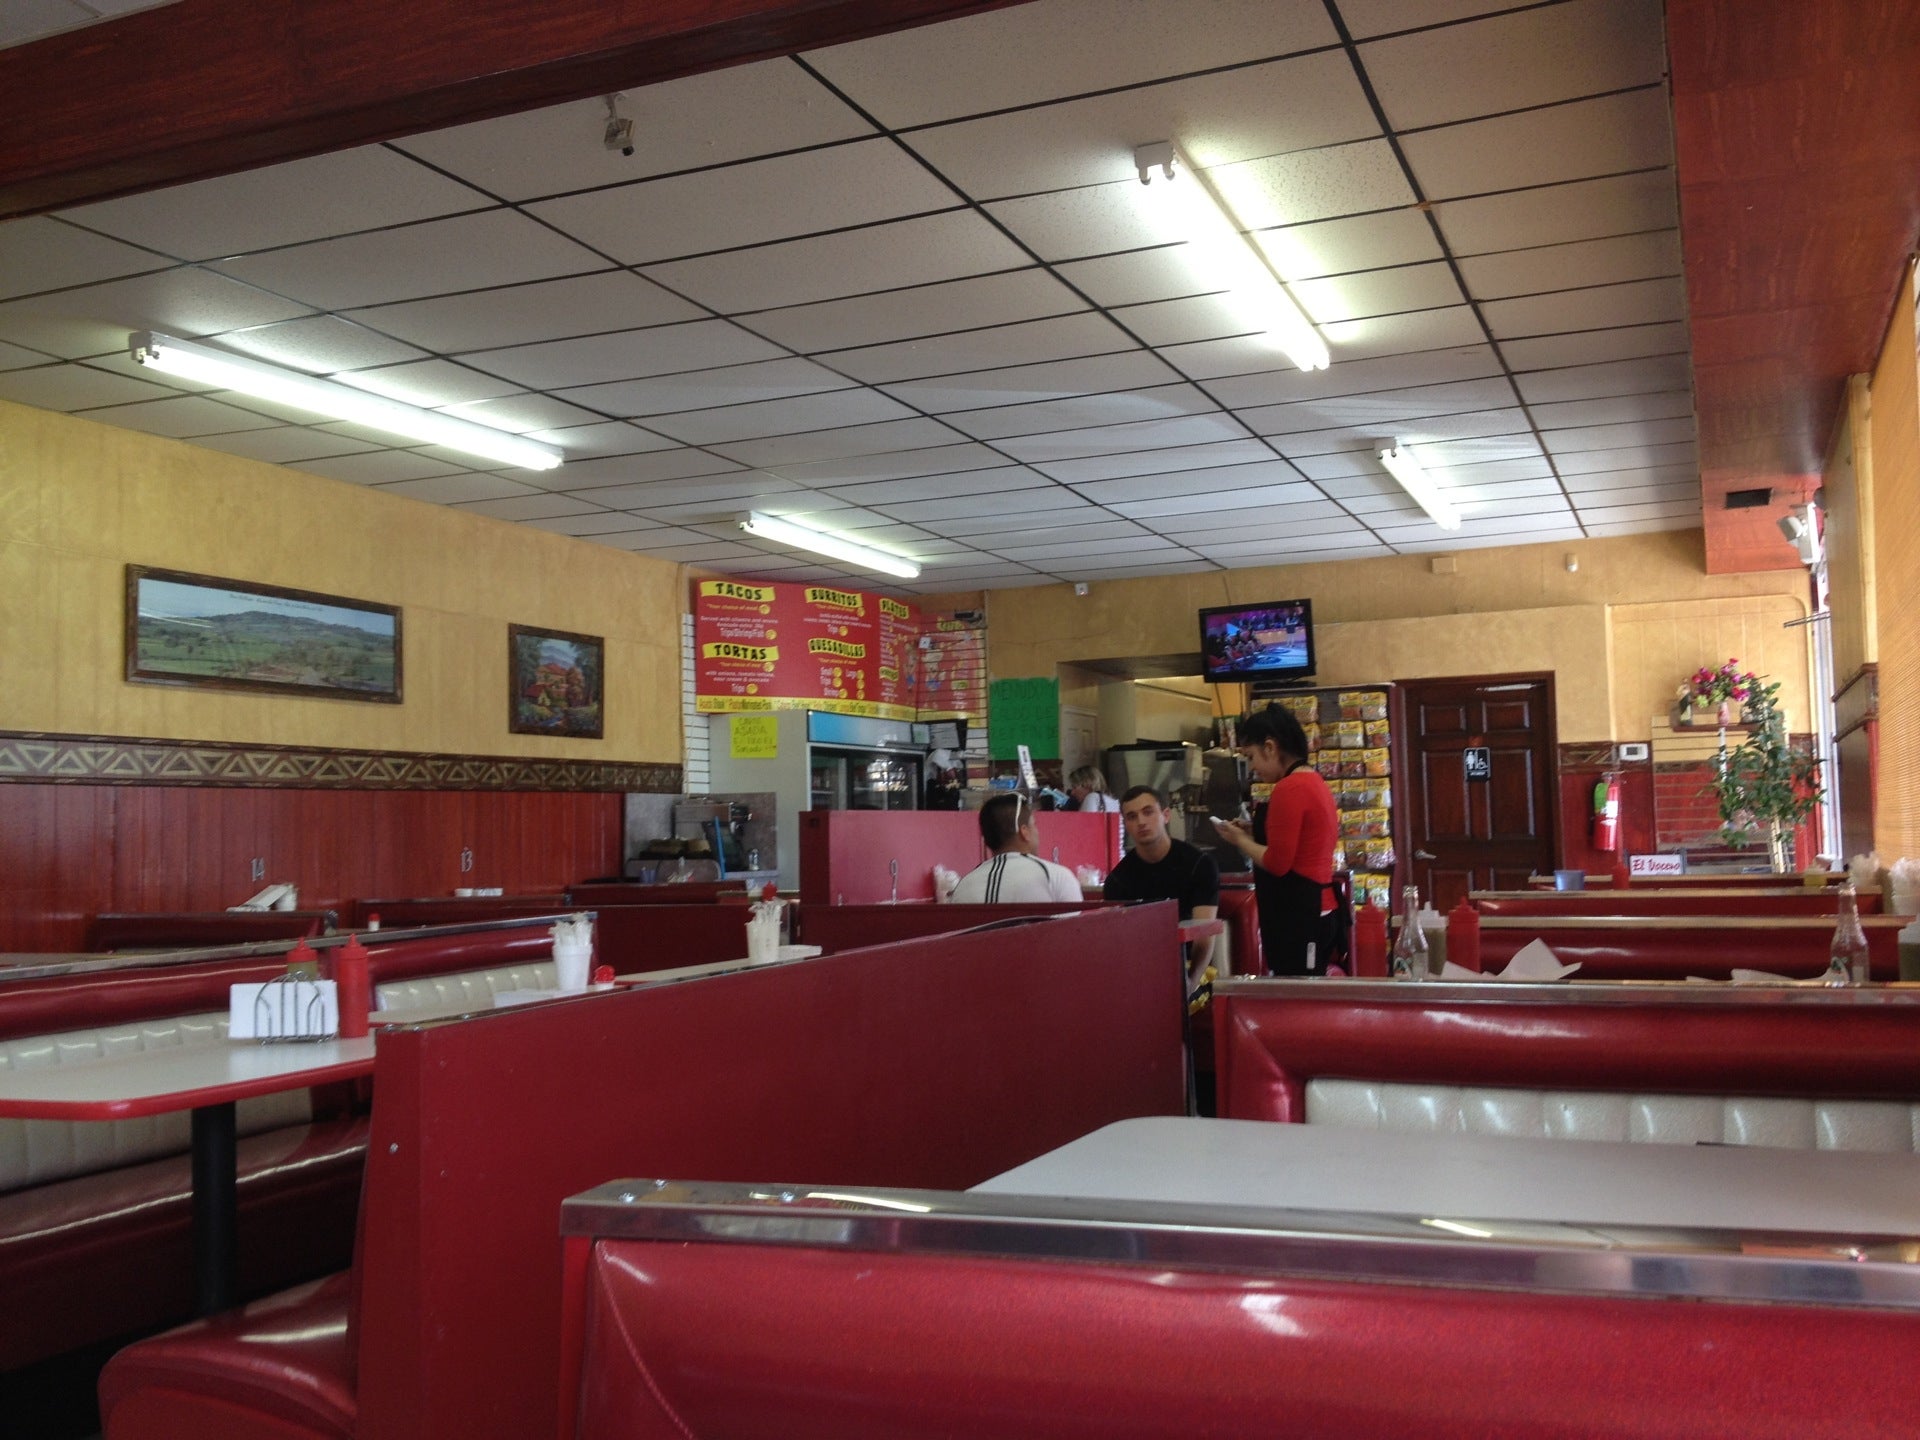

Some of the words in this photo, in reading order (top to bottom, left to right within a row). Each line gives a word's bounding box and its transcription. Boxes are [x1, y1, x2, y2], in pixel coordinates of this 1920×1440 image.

[715, 583, 762, 600] TACOS
[811, 589, 857, 606] BURRITOS
[714, 644, 767, 660] TORTAS
[810, 639, 863, 657] QUESADILLAS
[461, 848, 473, 873] 13
[1632, 858, 1645, 871] El
